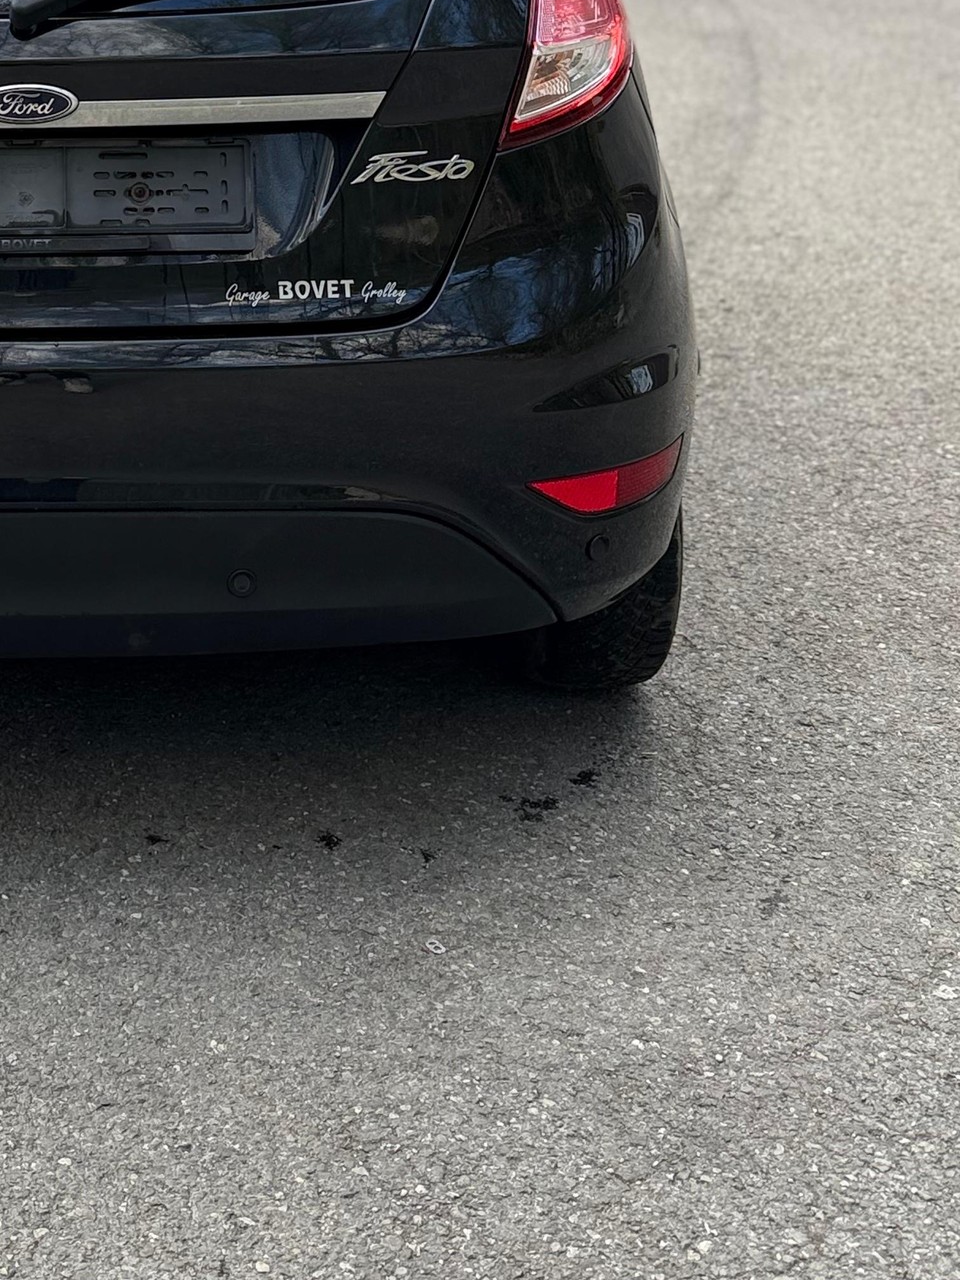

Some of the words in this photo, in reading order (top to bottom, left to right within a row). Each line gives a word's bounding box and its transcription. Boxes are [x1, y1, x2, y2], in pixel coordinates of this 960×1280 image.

[350, 150, 475, 185] Fiesta
[225, 283, 271, 307] Garage
[277, 279, 354, 300] BOVET
[361, 280, 407, 304] Grolley
